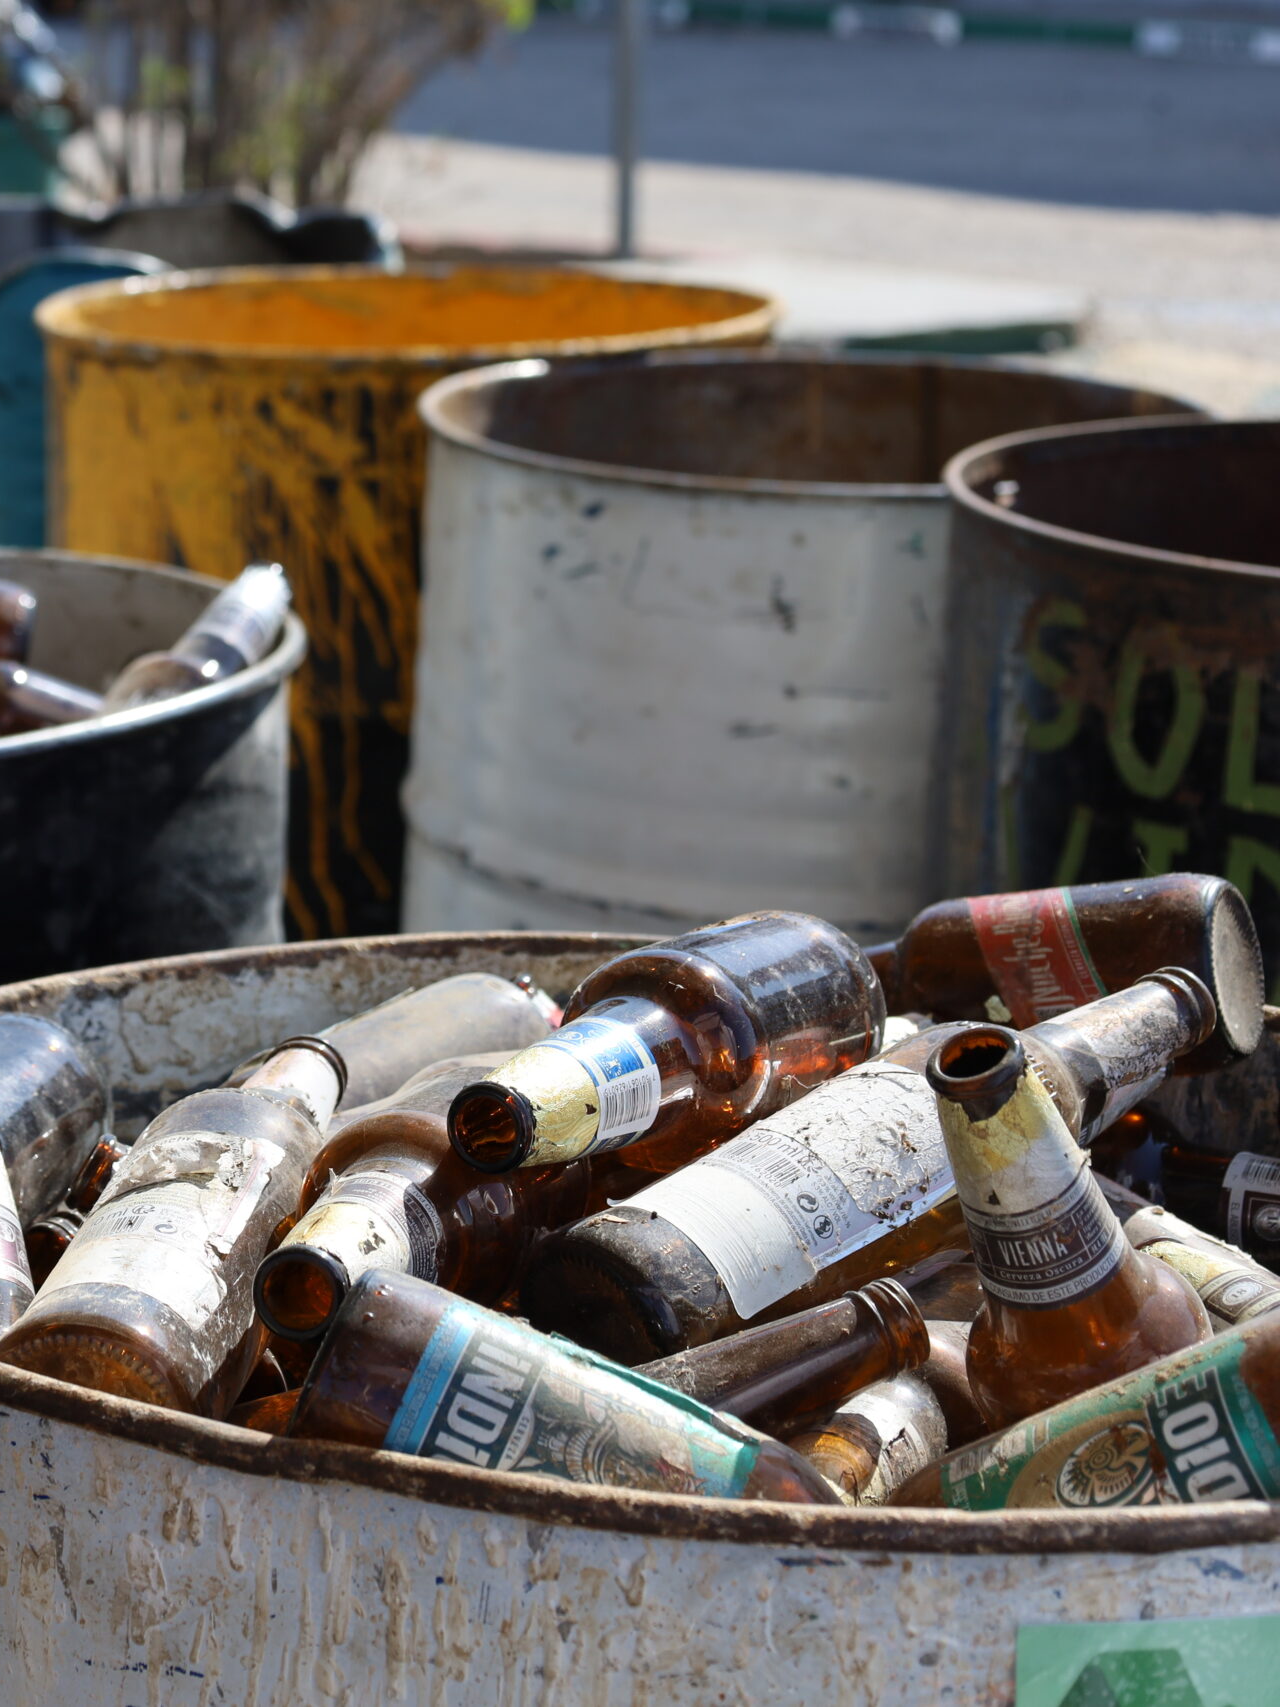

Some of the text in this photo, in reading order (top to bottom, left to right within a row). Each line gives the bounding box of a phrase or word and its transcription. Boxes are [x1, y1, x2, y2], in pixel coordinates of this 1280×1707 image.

[998, 1232, 1069, 1267] VIENNA
[1000, 1257, 1085, 1282] Cerveza Oscura
[989, 1282, 1031, 1302] CONSUMO
[1033, 1291, 1046, 1302] DE
[1048, 1283, 1074, 1300] ESTE
[432, 1342, 532, 1466] INDI
